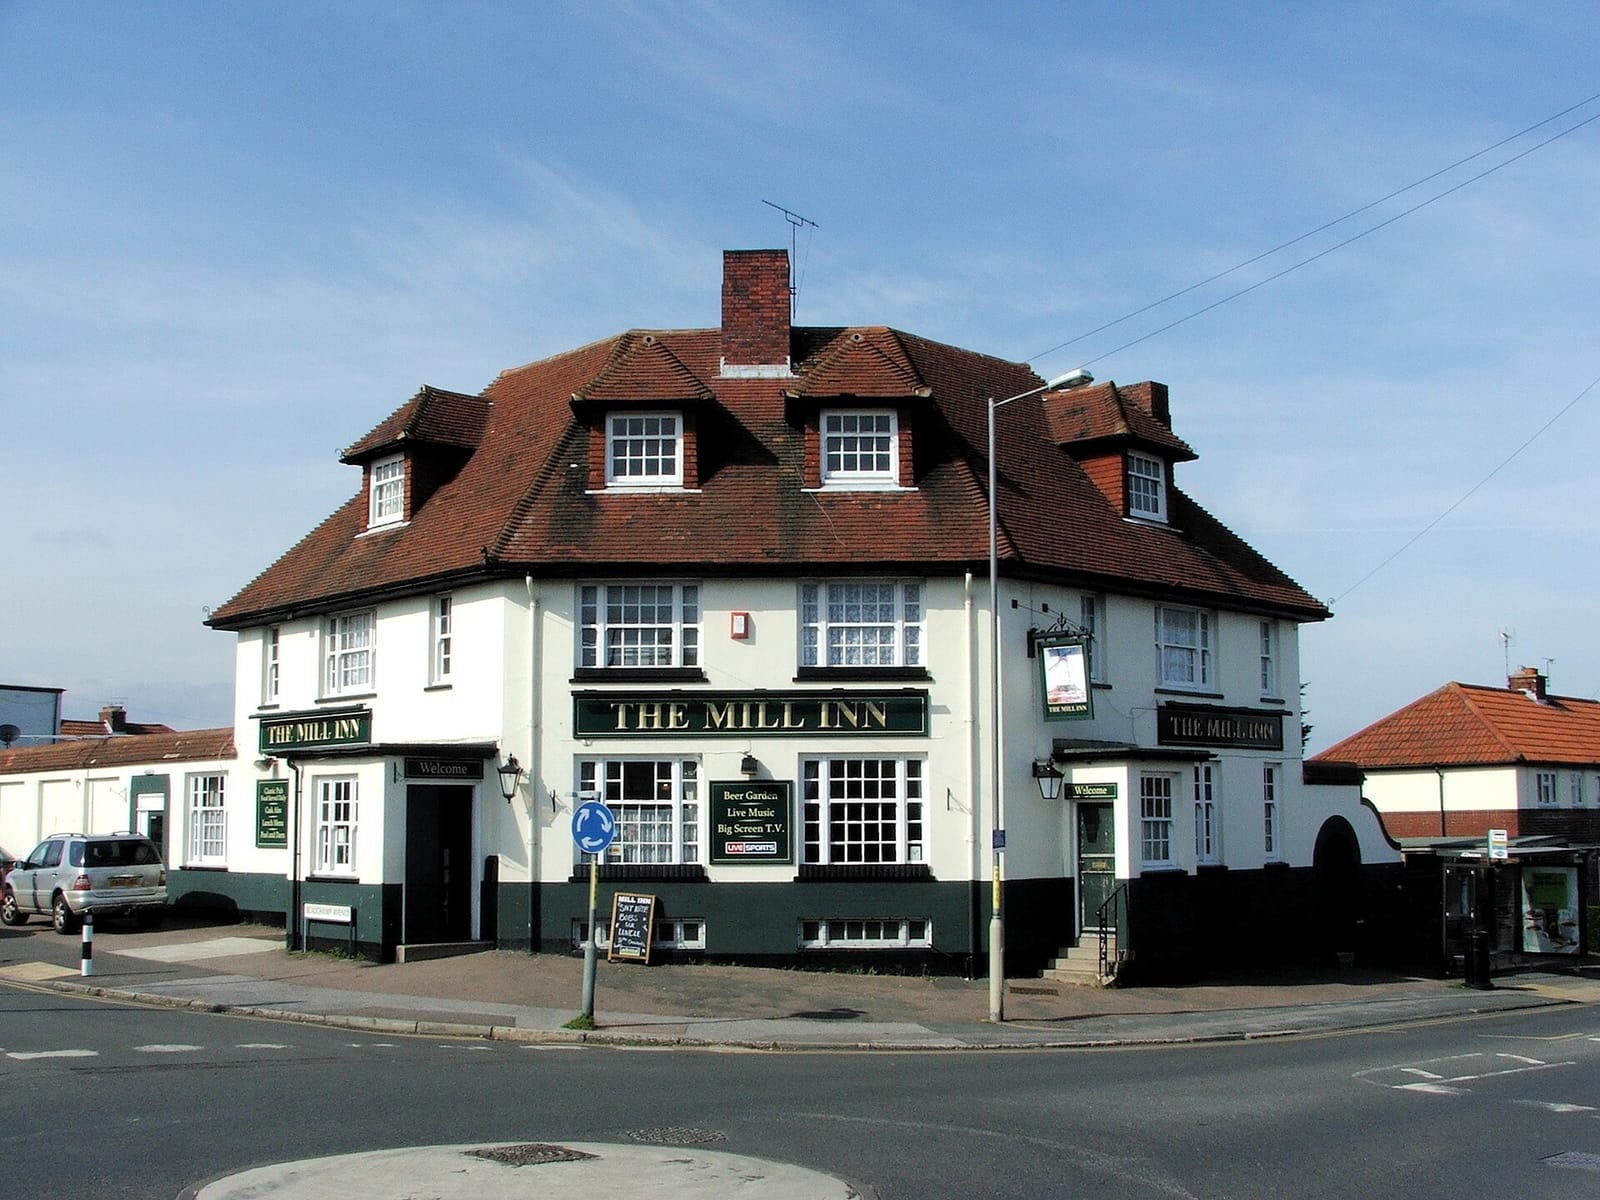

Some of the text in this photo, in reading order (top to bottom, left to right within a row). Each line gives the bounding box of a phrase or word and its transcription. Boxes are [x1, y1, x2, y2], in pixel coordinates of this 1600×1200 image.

[610, 700, 887, 730] THE MILL INN
[267, 718, 361, 744] THE MILL INN
[1170, 716, 1273, 740] THE MILL INN
[419, 761, 468, 775] Welcome
[723, 790, 778, 800] Beer Garden
[1074, 785, 1108, 795] Welcome
[727, 807, 775, 817] Live Music
[717, 823, 785, 836] Big Screen T.V.
[727, 844, 776, 852] LIVE SPORTS
[618, 896, 636, 904] MILL
